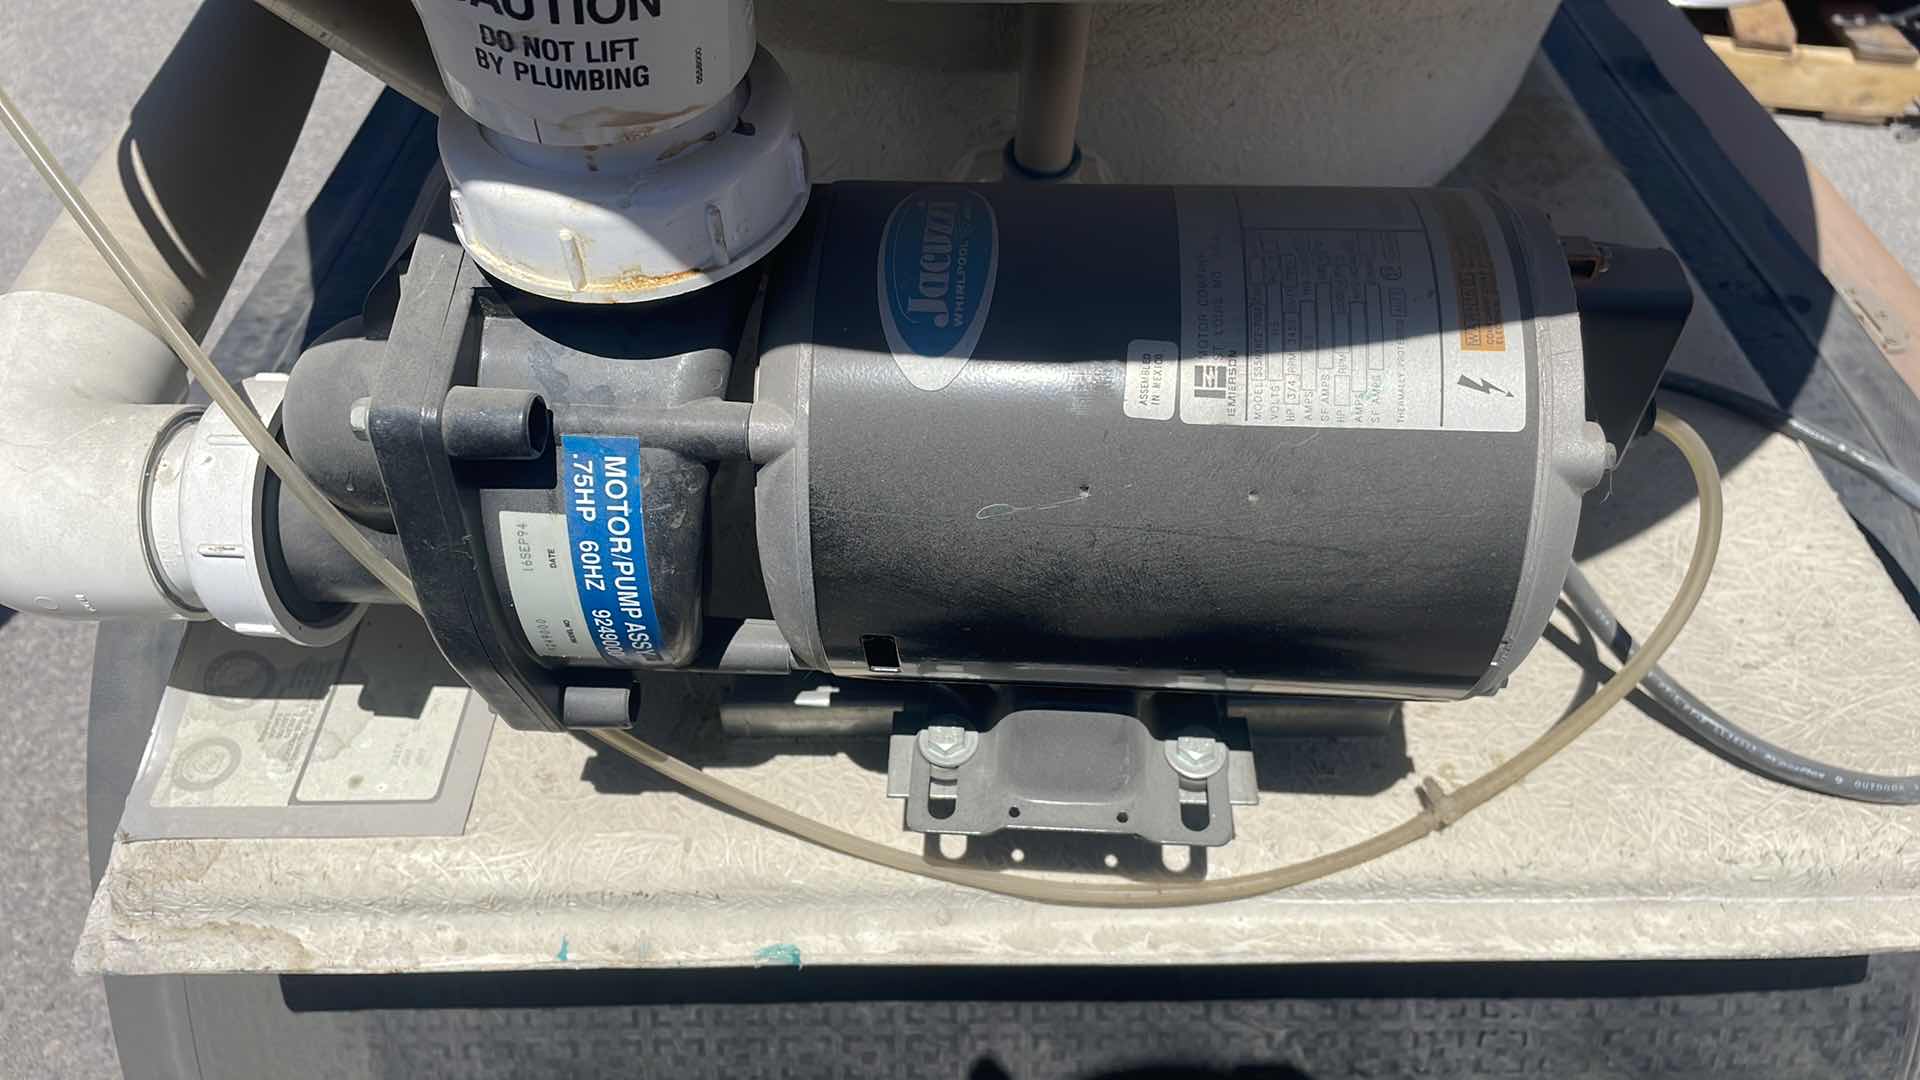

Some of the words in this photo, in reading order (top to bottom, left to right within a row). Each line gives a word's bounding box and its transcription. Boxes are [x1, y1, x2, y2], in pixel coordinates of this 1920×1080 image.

[480, 24, 515, 52] DO
[524, 36, 575, 63] NOT
[585, 37, 639, 64] LIFT
[474, 47, 504, 75] BY
[514, 61, 649, 91] PLUMBING
[907, 199, 959, 328] Jacuzzi
[953, 239, 969, 327] WHIRLPOOL
[1139, 353, 1151, 406] ASSEMBLED
[1153, 354, 1162, 389] MEXICO
[1321, 374, 1330, 404] AMPS
[1151, 394, 1160, 406] IN
[1254, 383, 1263, 420] MODEL
[1270, 385, 1280, 420] VOLTS
[1287, 380, 1296, 400] 3/4
[1304, 391, 1313, 421] AMPS
[1287, 408, 1296, 422] HP
[1321, 407, 1330, 422] SF
[1337, 410, 1345, 423] HP
[1354, 393, 1363, 423] AMPS
[1372, 407, 1380, 424] SF
[572, 453, 595, 522] .75HP
[517, 523, 534, 572] 16SEP94
[603, 456, 643, 618] MOTOR/PUMP
[547, 548, 557, 568] DATE
[578, 540, 605, 592] 60HZ
[591, 609, 625, 657] 9249000
